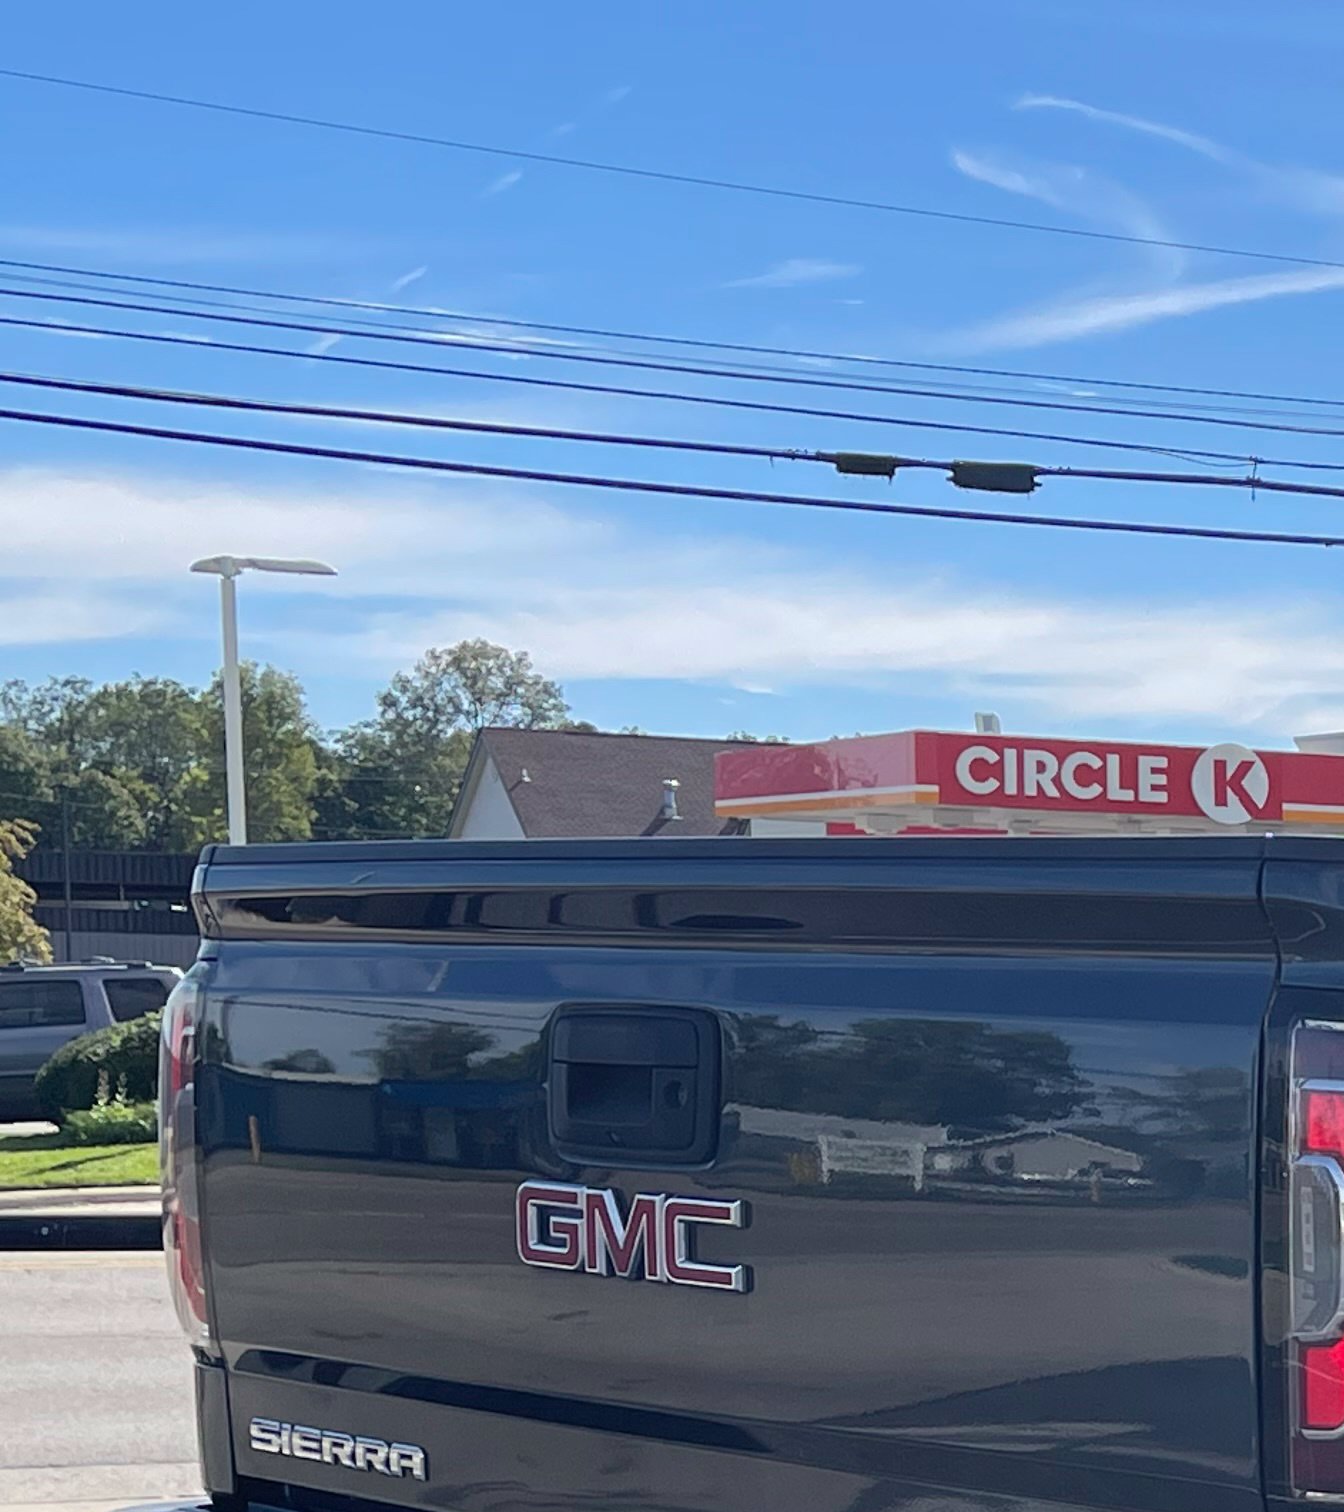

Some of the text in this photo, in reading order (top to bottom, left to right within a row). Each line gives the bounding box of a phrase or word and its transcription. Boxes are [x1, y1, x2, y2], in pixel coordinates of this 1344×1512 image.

[955, 744, 1266, 821] CIRCLE K
[515, 1178, 746, 1292] GMC
[249, 1416, 428, 1482] SIERRA
